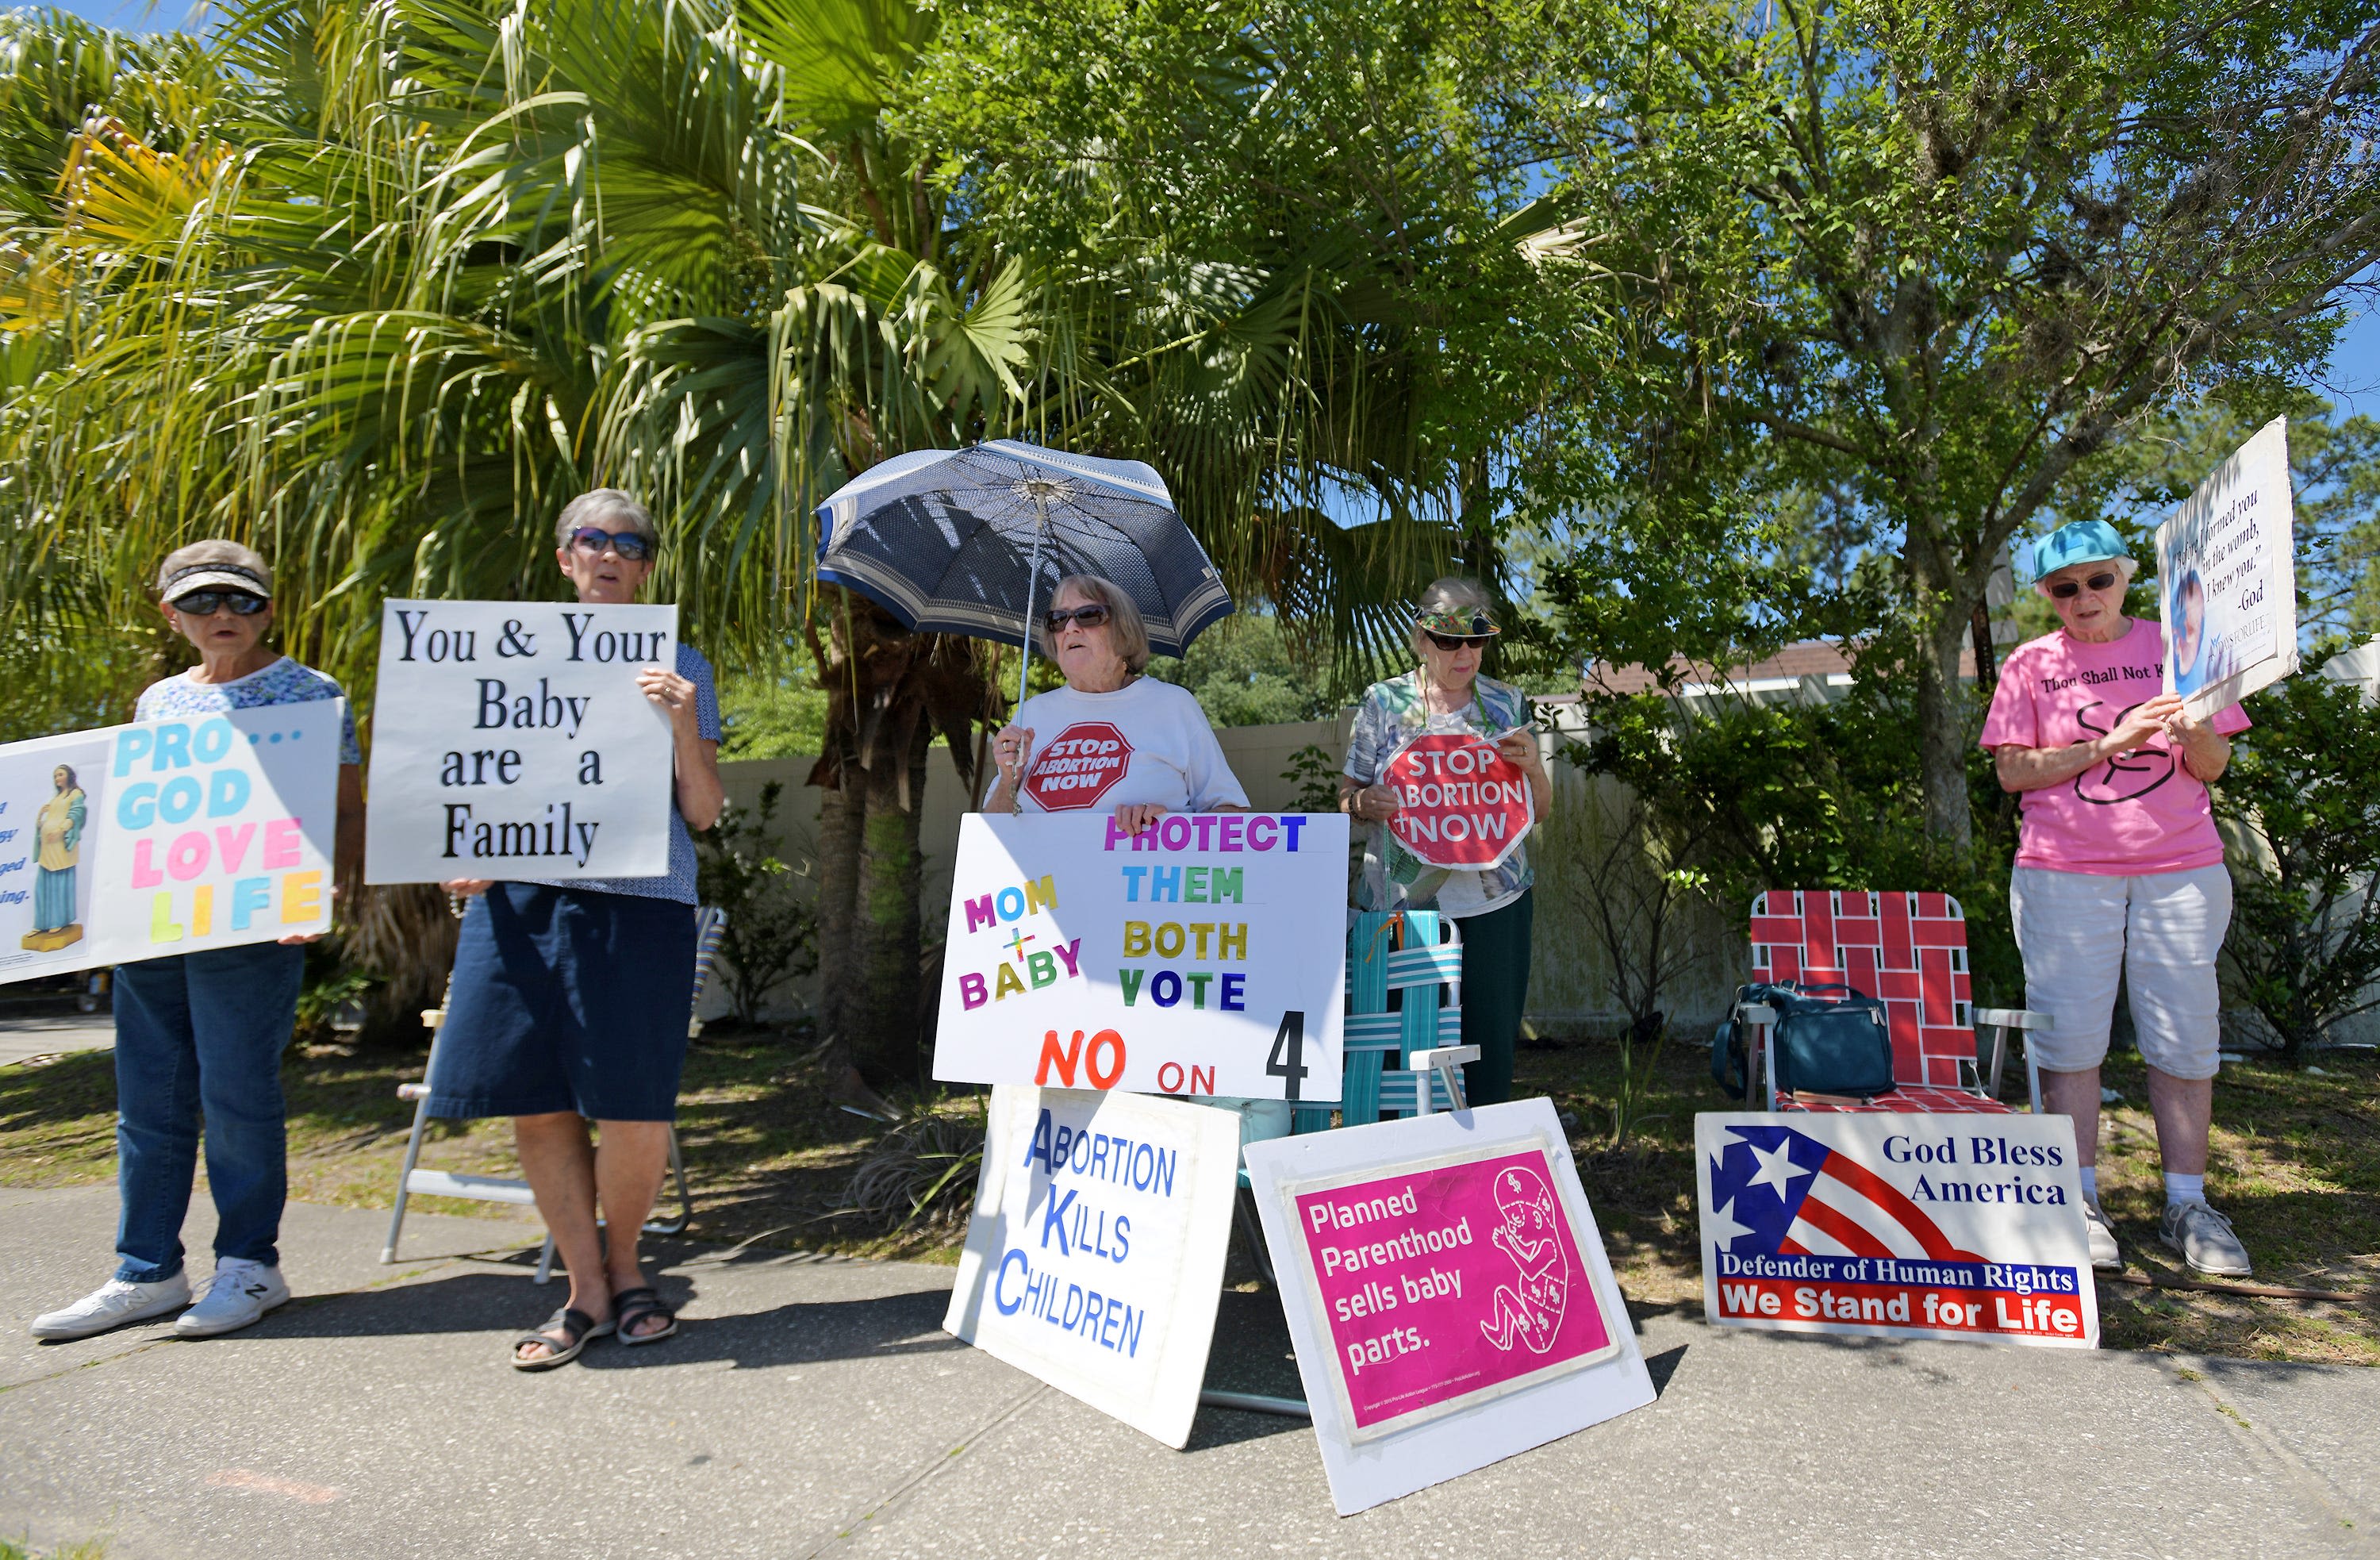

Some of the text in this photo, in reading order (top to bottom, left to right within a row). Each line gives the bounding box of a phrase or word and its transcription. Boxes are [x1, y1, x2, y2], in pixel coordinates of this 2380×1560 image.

[2204, 499, 2236, 551] formed
[2237, 490, 2259, 524] you
[2203, 517, 2260, 577] in the womb,
[2206, 583, 2211, 603] I
[2212, 570, 2234, 598] knew
[2237, 578, 2263, 611] -God
[396, 610, 666, 663] You & Your
[2041, 678, 2077, 694] Thou
[2081, 667, 2119, 685] Shall
[2121, 667, 2151, 680] Not
[474, 677, 591, 740] Baby
[441, 748, 604, 787] are a
[1033, 756, 1122, 777] ABORTION
[1048, 739, 1119, 758] STOP
[1407, 749, 1496, 777] STOP
[117, 768, 251, 831] GOD
[1040, 772, 1102, 793] NOW
[1392, 780, 1523, 809] ABORTION
[442, 801, 600, 869] Family
[1104, 816, 1307, 852] PROTECT
[1410, 812, 1507, 843] NOW
[131, 817, 302, 890] LOVE
[150, 870, 323, 943] LIFE
[963, 874, 1059, 934] MOM
[1122, 866, 1244, 905] THEM
[1123, 920, 1248, 961] BOTH
[958, 938, 1081, 1012] BABY
[1119, 969, 1246, 1012] VOTE
[1035, 1011, 1308, 1099] NO ON 4
[1023, 1108, 1177, 1197] ABORTION
[1883, 1135, 2063, 1167] God Bless
[1308, 1185, 1418, 1234] Planned
[1910, 1174, 2068, 1206] America
[1041, 1182, 1131, 1263] KILLS
[1320, 1216, 1474, 1278] Parenthood
[1334, 1267, 1463, 1324] sells baby
[1721, 1252, 2075, 1296] Defender of Human Rights
[995, 1248, 1145, 1359] CHILDREN
[1722, 1284, 1782, 1316] We
[1794, 1288, 1910, 1323] Stand
[1923, 1297, 1983, 1328] for
[1995, 1297, 2079, 1333] Life
[1347, 1323, 1431, 1376] parts.
